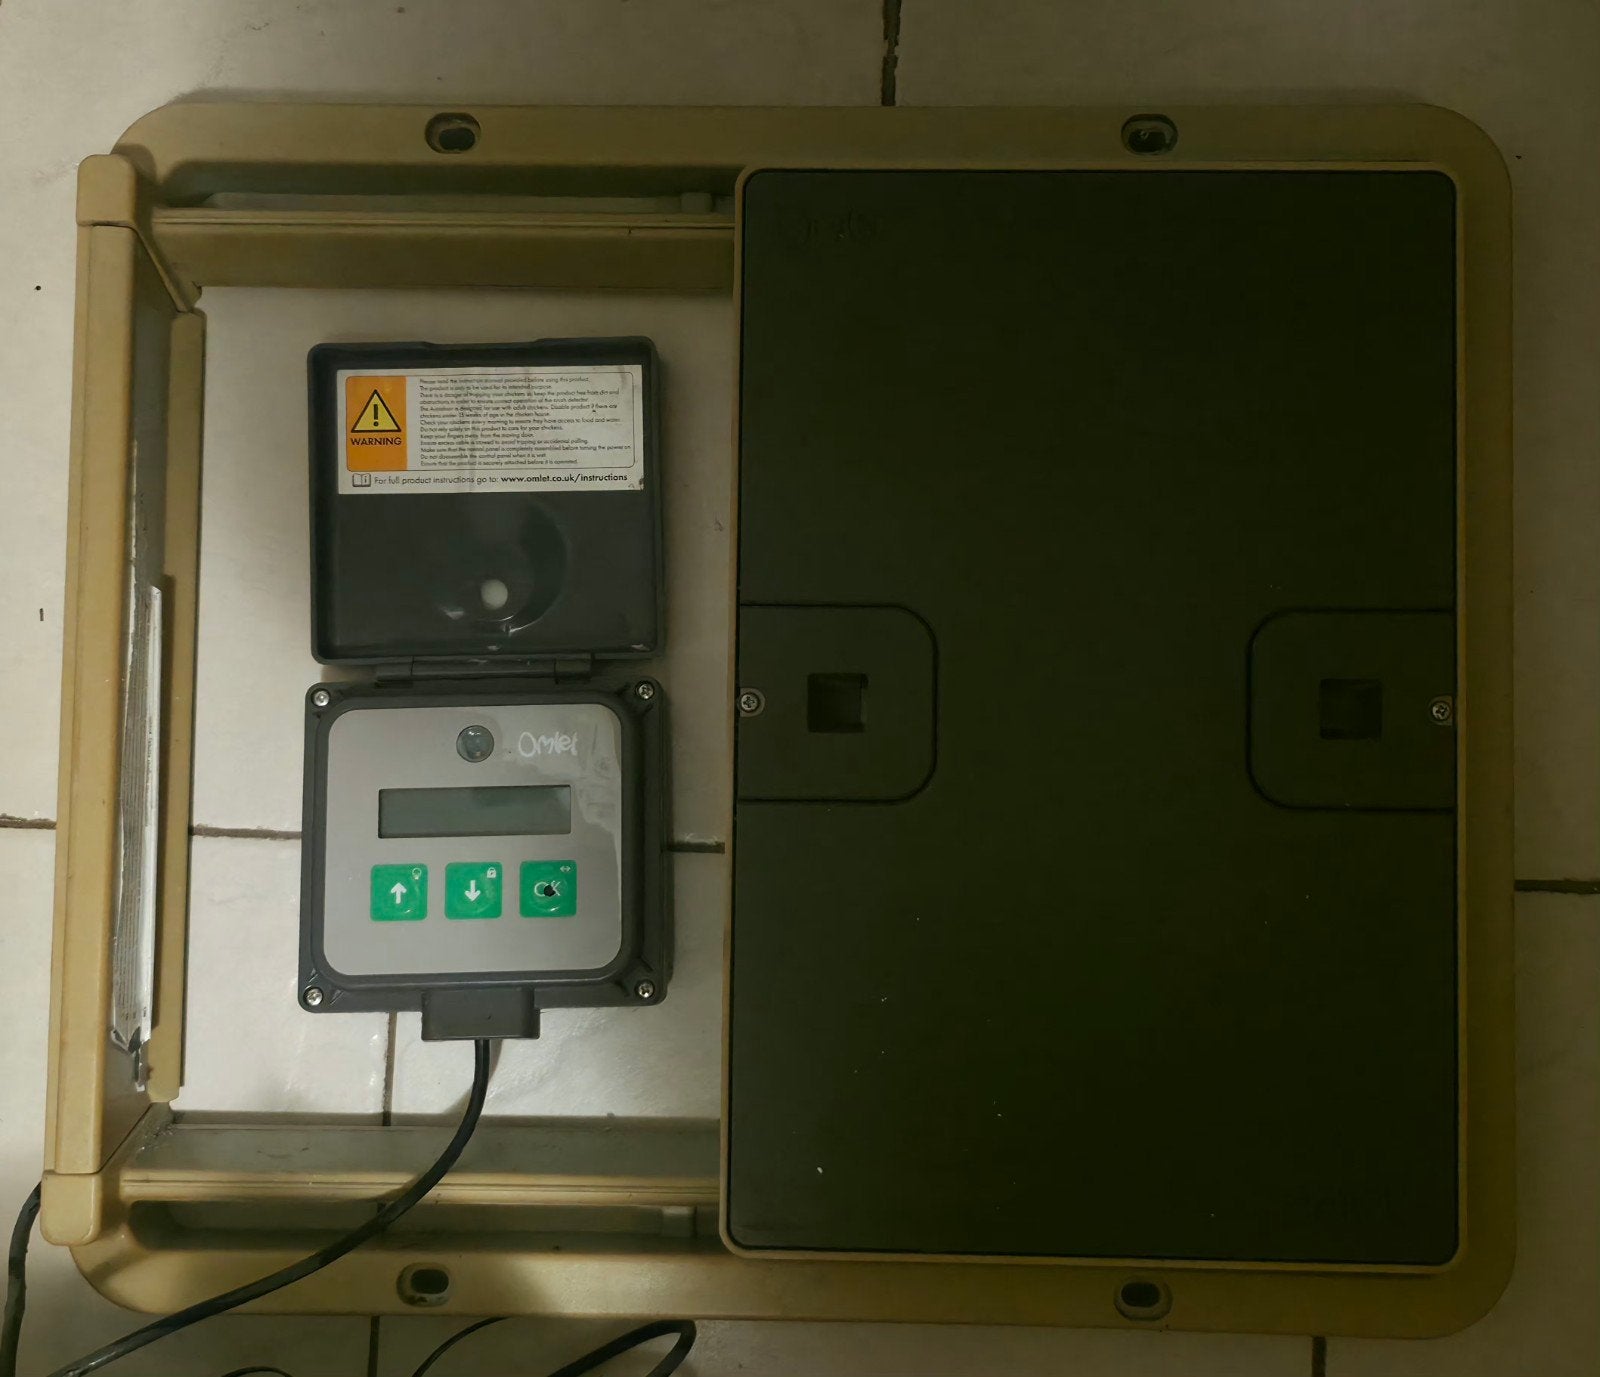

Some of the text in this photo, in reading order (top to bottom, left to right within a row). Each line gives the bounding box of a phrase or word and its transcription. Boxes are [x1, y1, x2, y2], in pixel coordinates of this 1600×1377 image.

[351, 437, 402, 446] WARNING
[374, 473, 628, 486] For full product instructions go to: www.omlet.co.uk/instructions
[534, 880, 561, 897] OK
